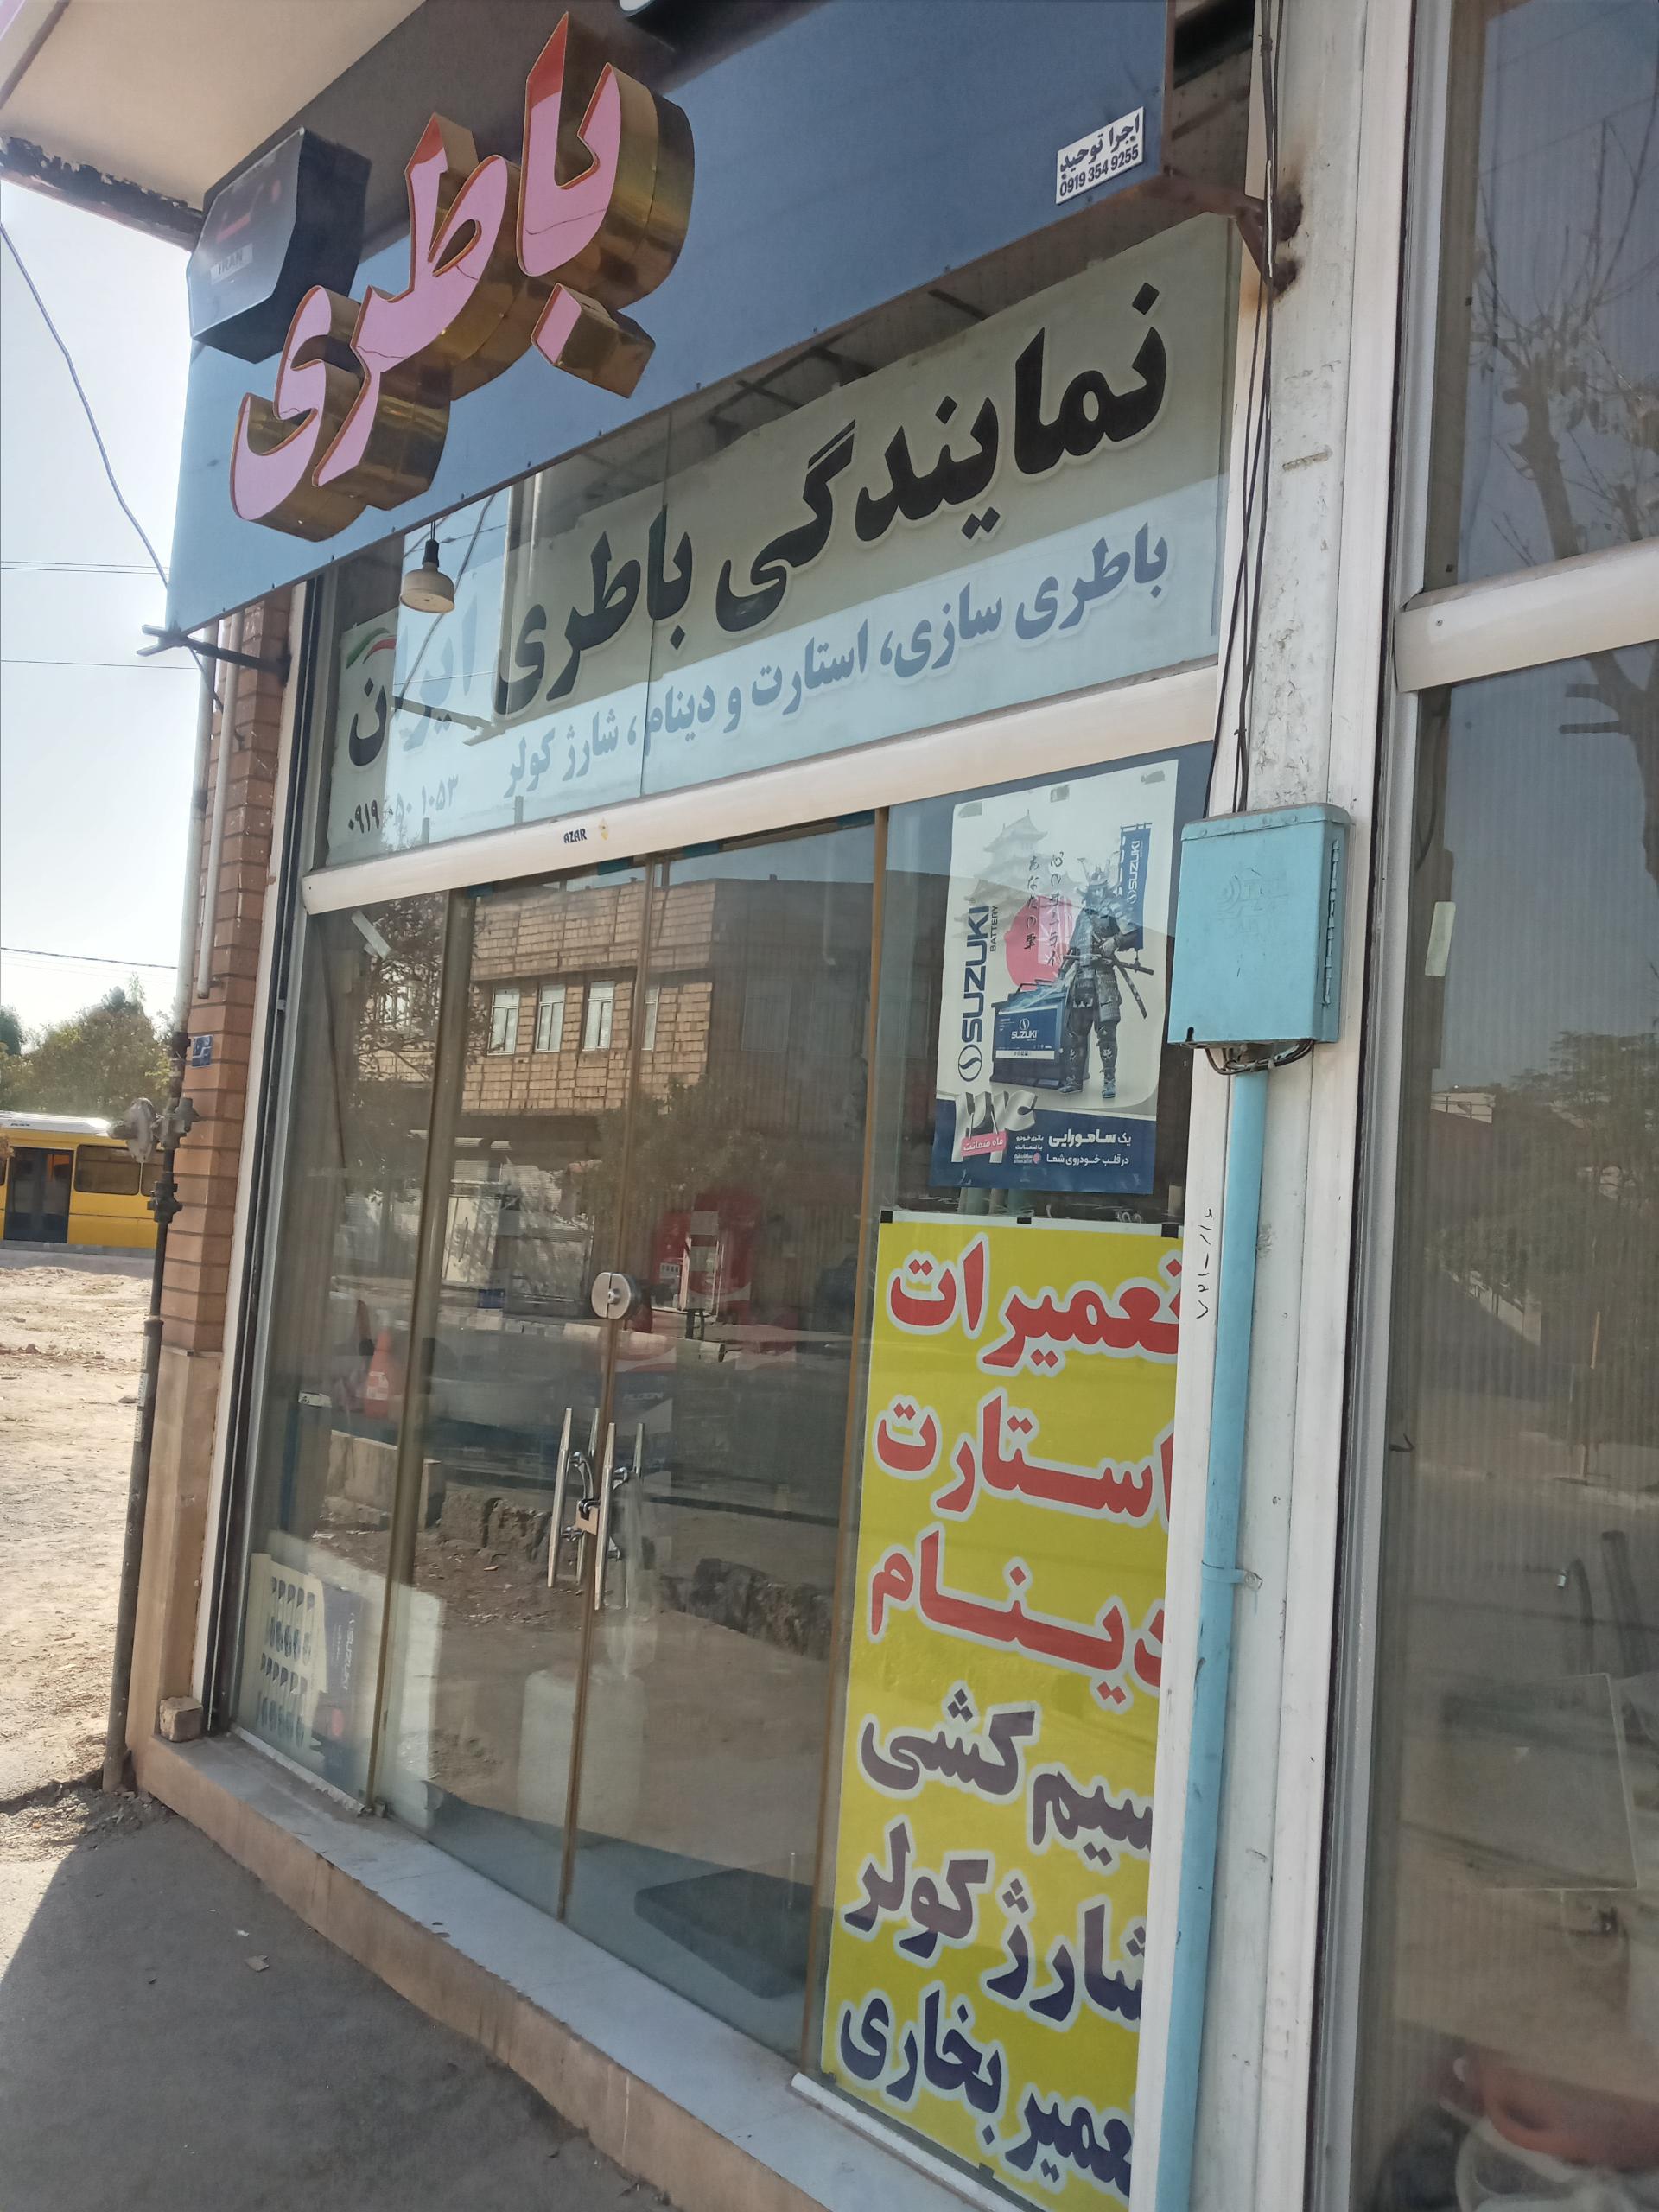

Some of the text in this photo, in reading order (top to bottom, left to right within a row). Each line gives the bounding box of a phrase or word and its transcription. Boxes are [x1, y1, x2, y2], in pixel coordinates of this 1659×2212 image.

[1060, 113, 1140, 172] اجرا توحید
[1059, 143, 1139, 196] 0919 354 9255
[230, 12, 621, 520] باطری
[715, 283, 1166, 632] نمایندگی
[1016, 522, 1168, 639] باطری
[493, 505, 692, 715] باطری
[751, 619, 868, 715] استارت
[723, 686, 741, 734] و
[504, 727, 556, 798] کولر
[563, 709, 618, 781] شارژ
[348, 799, 380, 834] ۰۹۱۹
[563, 829, 588, 844] AZAR
[1128, 840, 1141, 890] SUZUKI
[989, 905, 1000, 953] BATTERY
[961, 905, 990, 1044] SUZUKI
[1011, 1030, 1037, 1039] SUZUKI
[963, 1140, 991, 1151] ضمانت
[1046, 1153, 1065, 1163] شما
[1048, 1128, 1132, 1147] یک سامورایی
[1065, 1154, 1101, 1166] خودروی
[1102, 1154, 1121, 1166] قلب
[1120, 1157, 1129, 1166] در
[861, 1689, 1035, 1796] کشی
[844, 1822, 988, 1958] کولر
[841, 1989, 1132, 2202] عمیر بخاری
